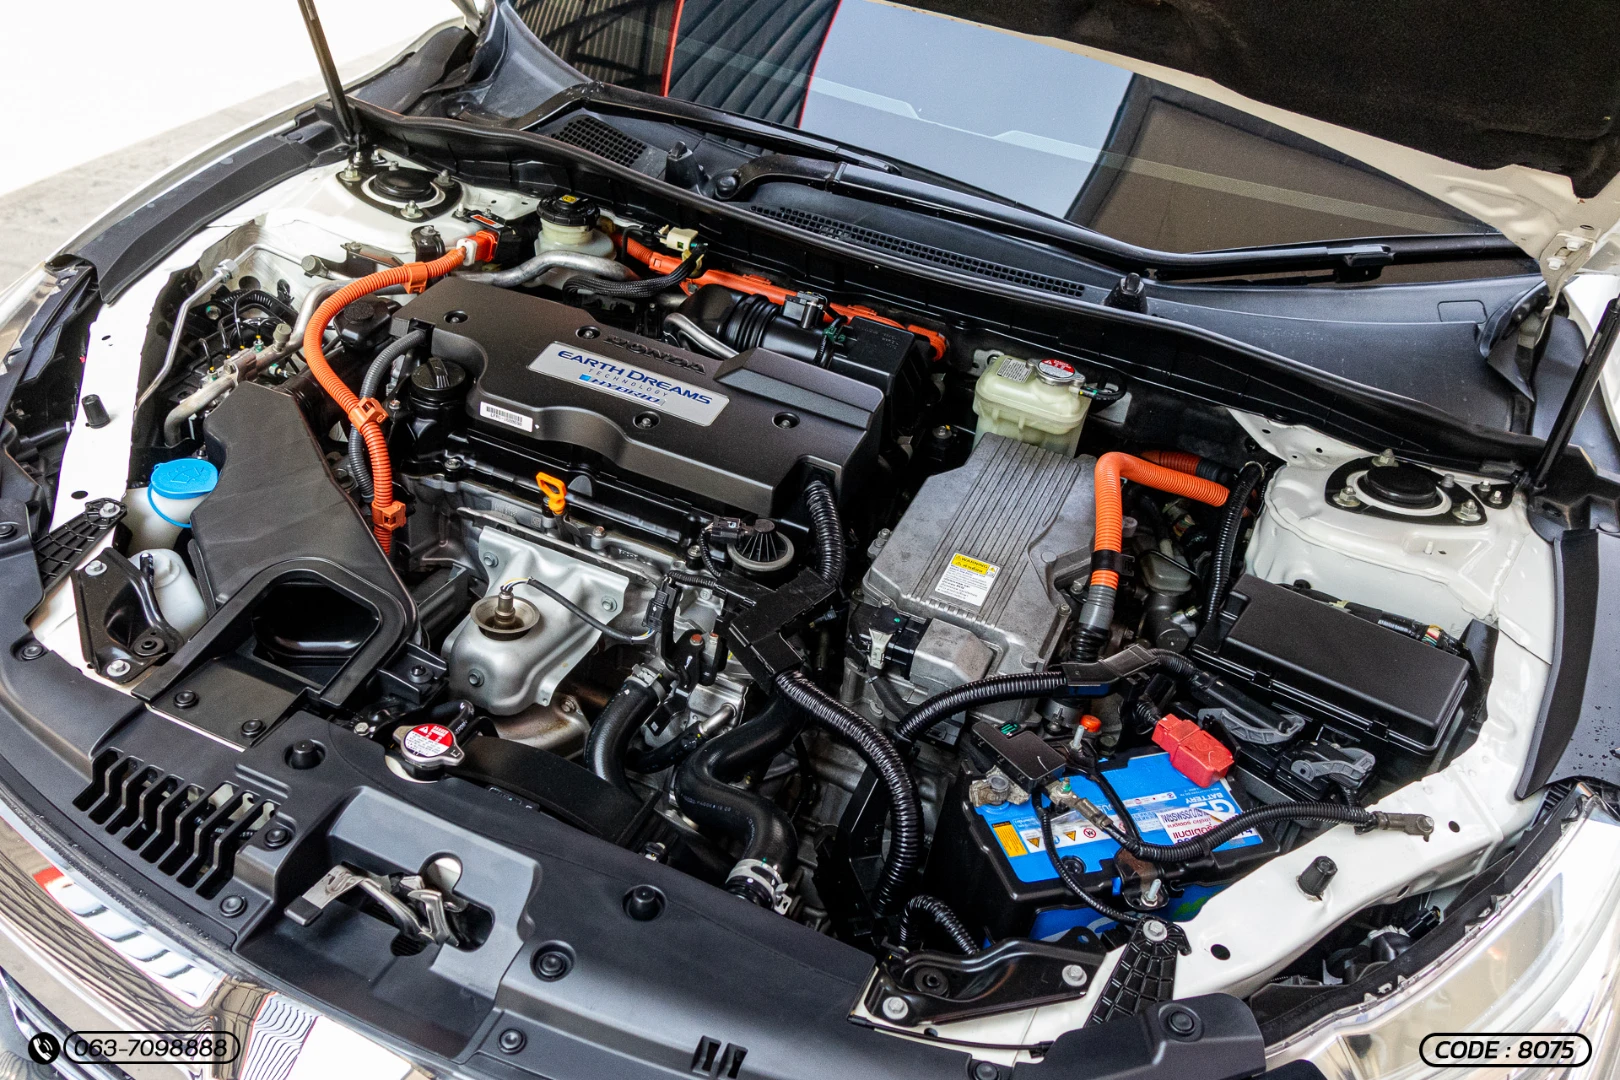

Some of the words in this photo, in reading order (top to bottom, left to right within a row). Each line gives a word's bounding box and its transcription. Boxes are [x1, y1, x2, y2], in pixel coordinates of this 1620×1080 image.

[603, 335, 706, 375] HONDA
[557, 350, 625, 376] EARTH
[626, 370, 713, 405] DREAMS
[588, 368, 669, 398] TECHNOLOGY
[591, 378, 662, 404] HYBRID
[1185, 792, 1224, 804] BATTERY
